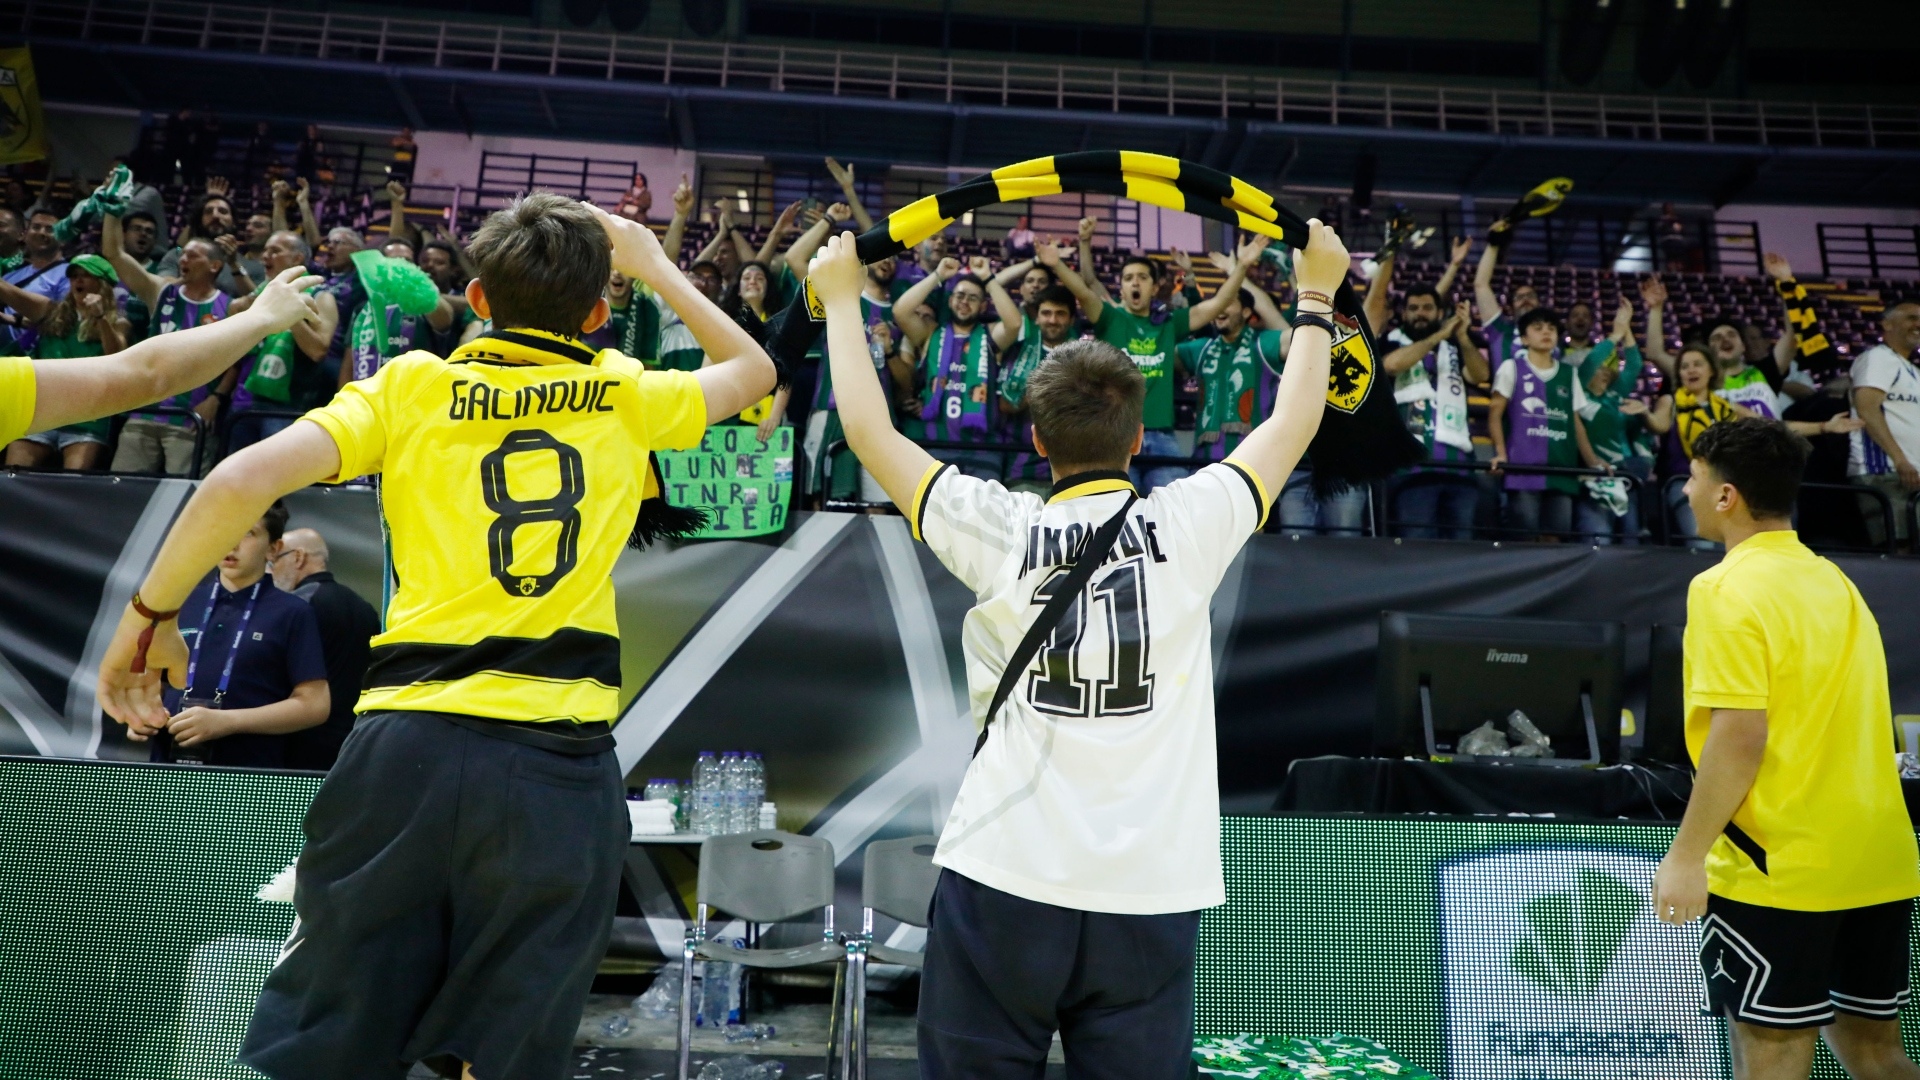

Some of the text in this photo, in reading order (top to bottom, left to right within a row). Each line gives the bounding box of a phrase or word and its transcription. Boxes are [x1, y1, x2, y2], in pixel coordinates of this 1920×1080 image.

[449, 379, 621, 421] GALINOVIC
[946, 396, 962, 419] 6
[480, 429, 586, 598] 8
[1027, 557, 1156, 719] 11
